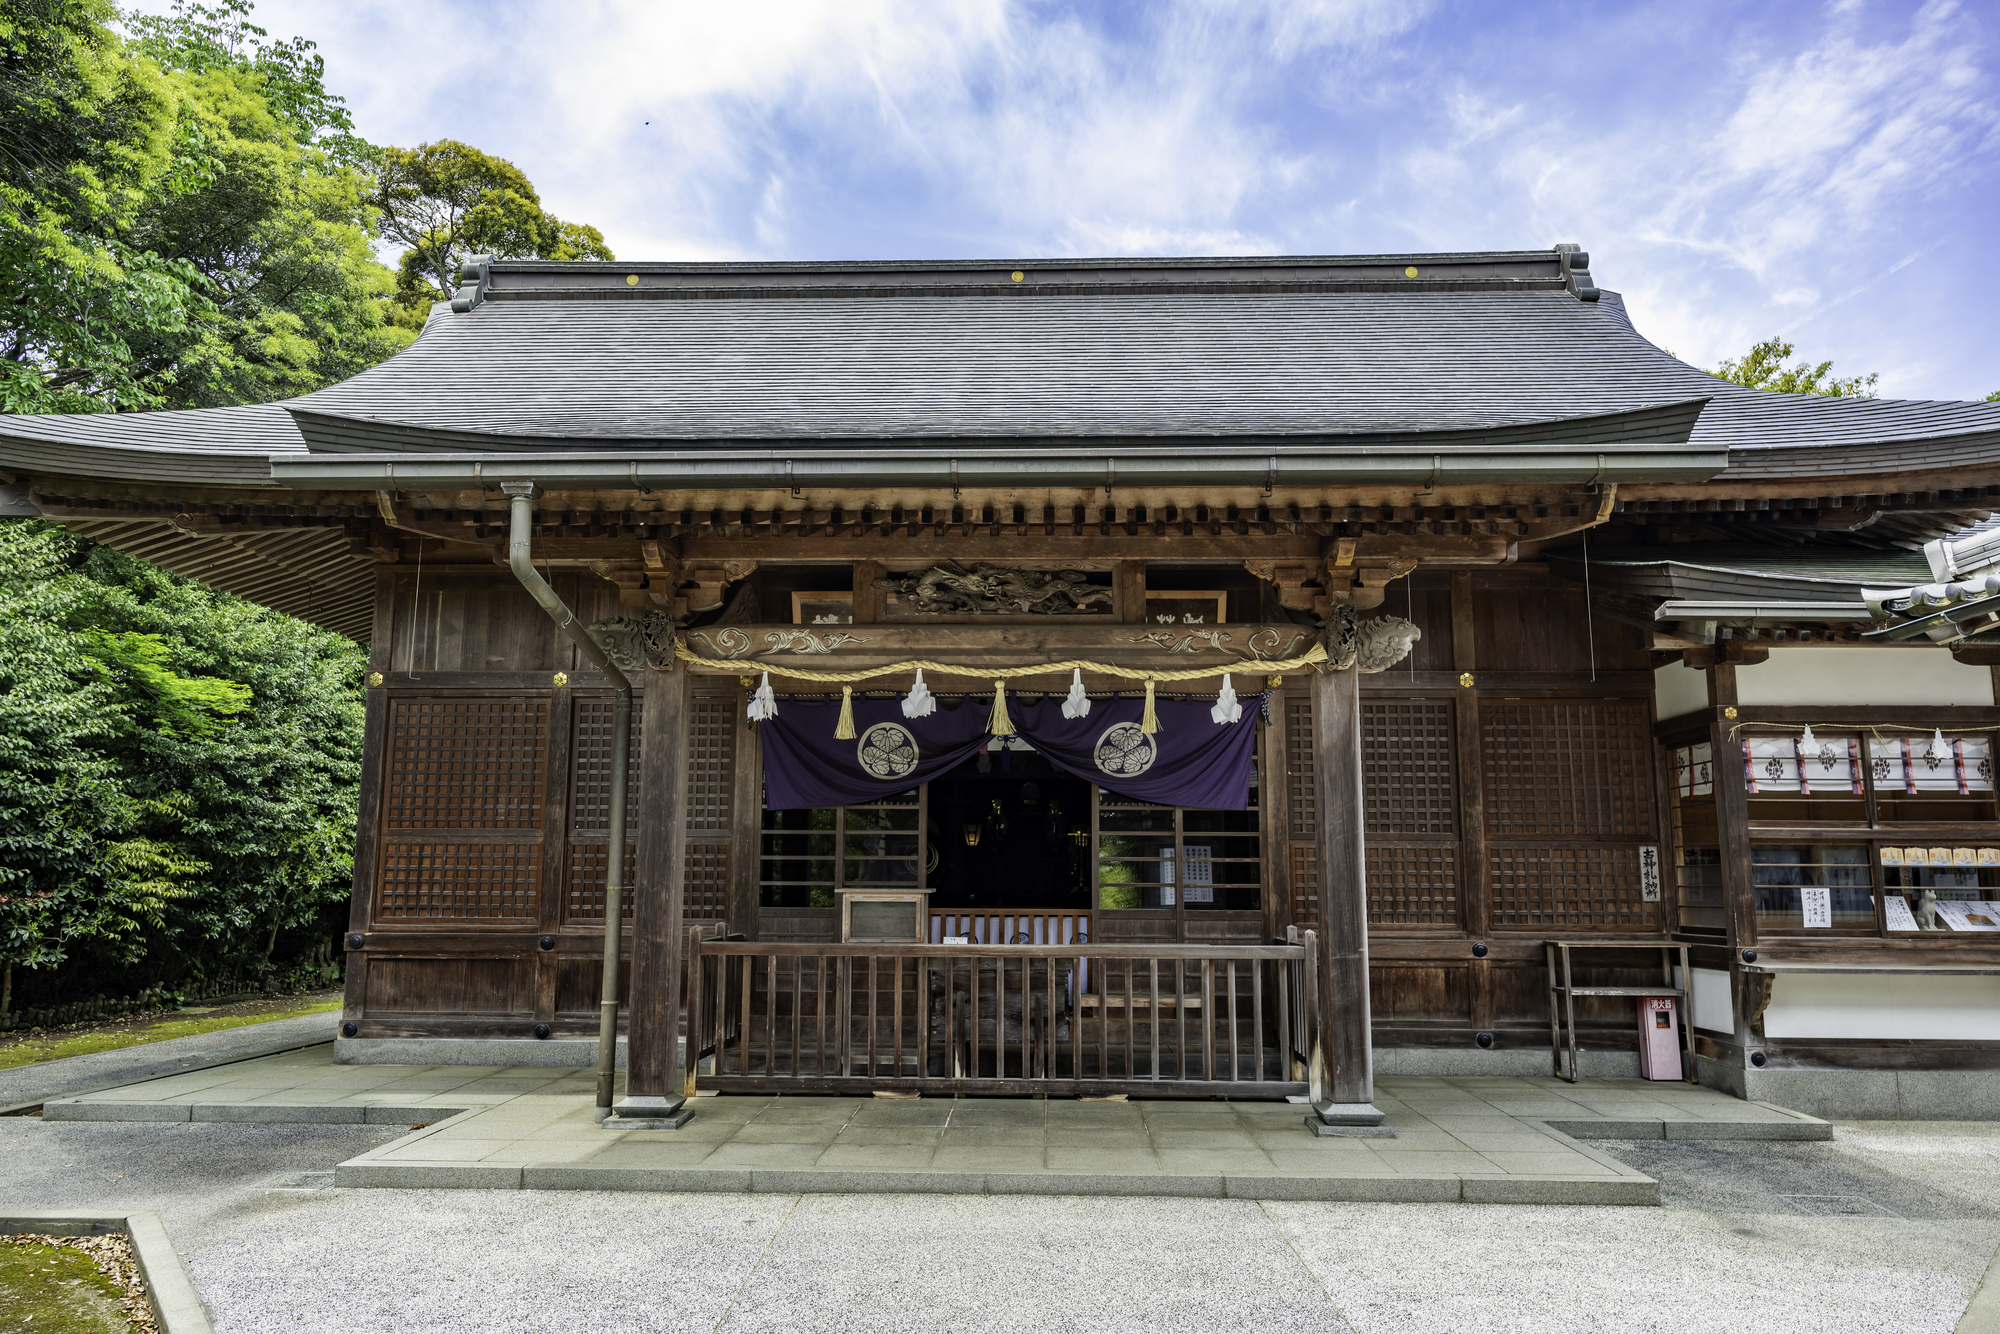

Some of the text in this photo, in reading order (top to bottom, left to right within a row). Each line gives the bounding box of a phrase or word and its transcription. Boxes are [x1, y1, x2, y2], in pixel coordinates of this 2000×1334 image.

[1642, 848, 1658, 899] 古神札納所
[1650, 999, 1672, 1009] 消火器
